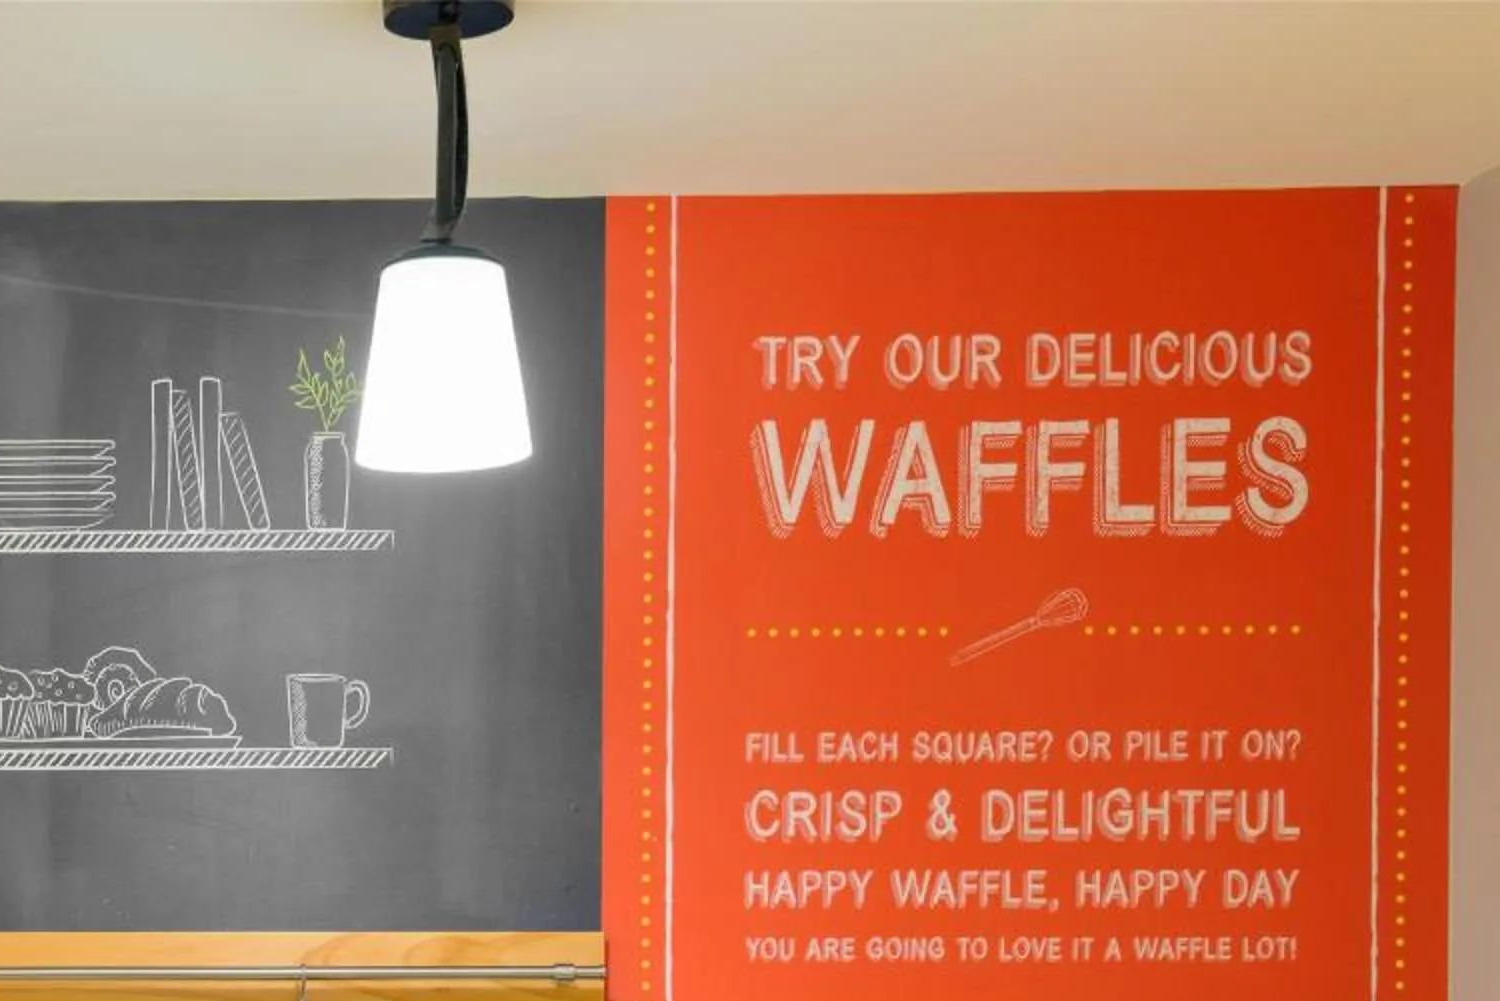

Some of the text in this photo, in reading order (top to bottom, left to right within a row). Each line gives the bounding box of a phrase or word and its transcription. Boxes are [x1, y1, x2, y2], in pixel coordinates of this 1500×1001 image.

[753, 329, 1313, 390] TRY OUR DELICIOUS
[748, 415, 1310, 538] WAFFLES
[745, 729, 1302, 764] FILL EACH SQUARE? OR PILE IT ON?
[745, 787, 1301, 842] CRISP & DELIGHTFUL
[744, 868, 1301, 913] HAPPY WAFFLE, HAPPY DAY
[745, 937, 1298, 962] YOU ARE GOING TO LOVE IT A WAFFLE LOT!
